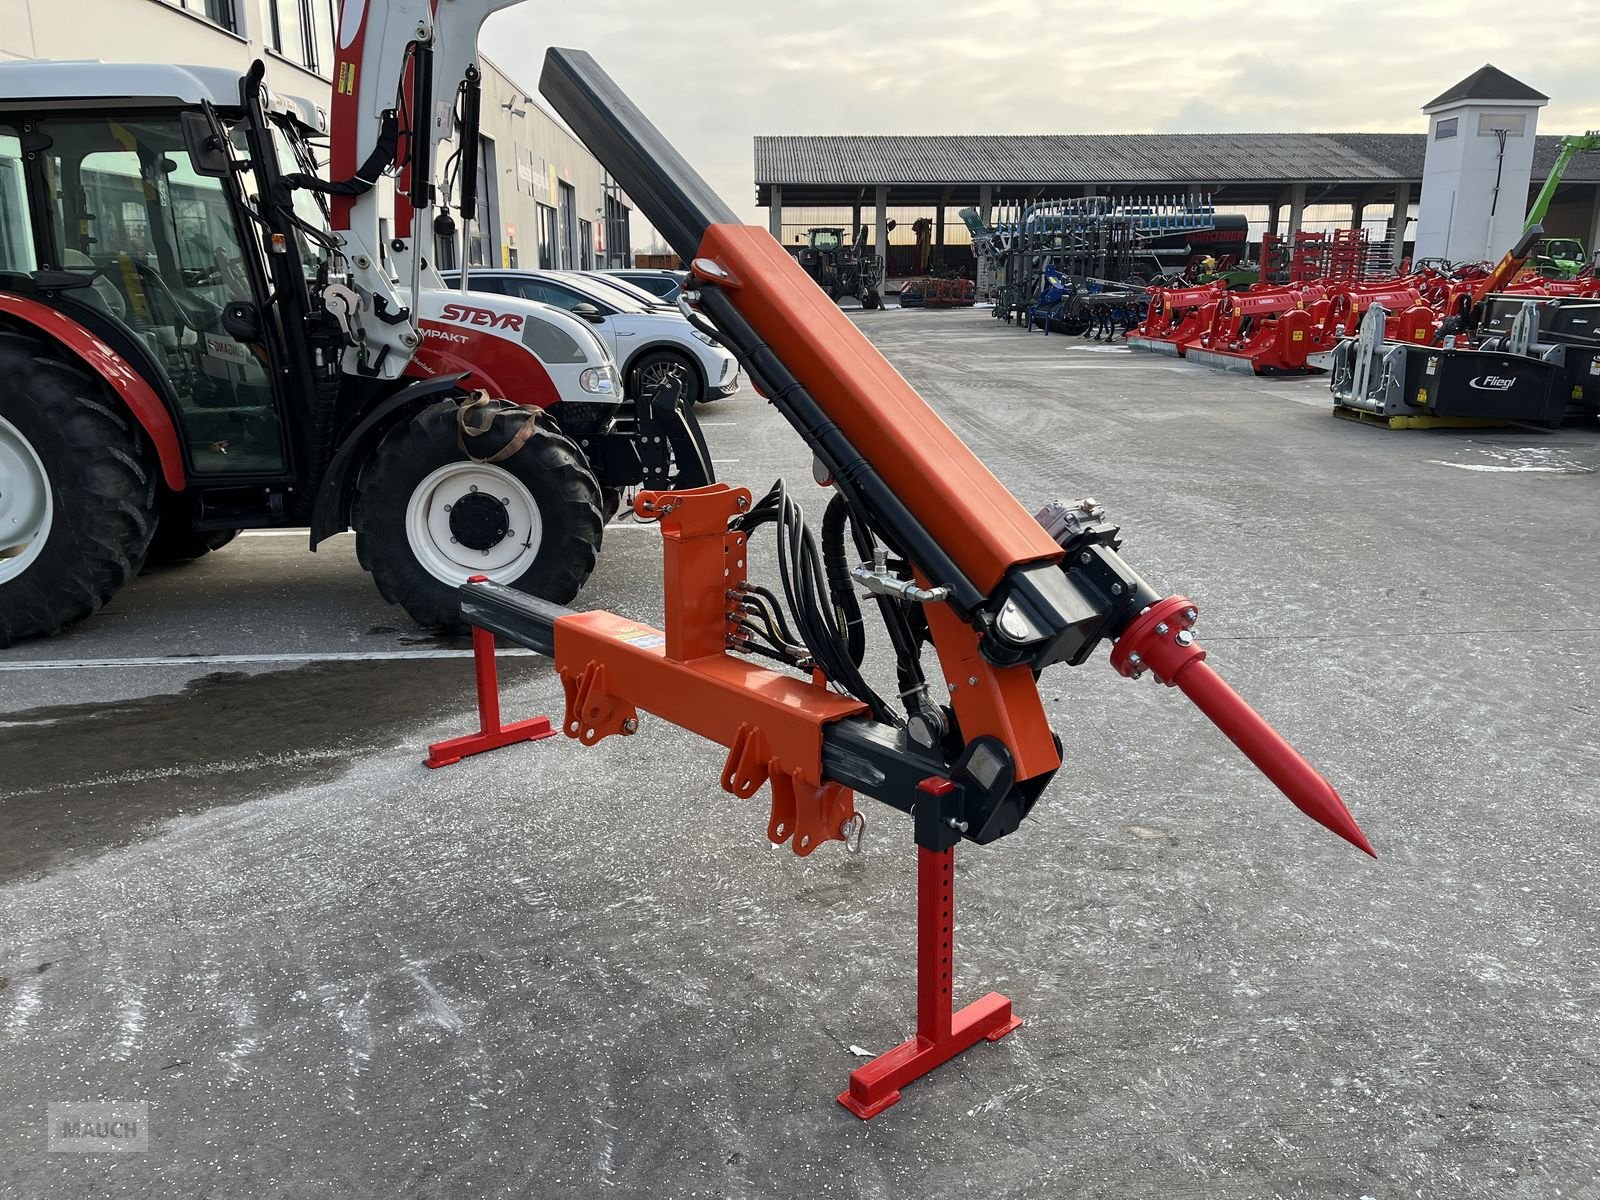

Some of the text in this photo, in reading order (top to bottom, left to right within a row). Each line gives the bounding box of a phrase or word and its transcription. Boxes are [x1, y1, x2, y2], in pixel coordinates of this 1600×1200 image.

[439, 303, 524, 332] STEYR
[419, 327, 469, 344] MPAKT
[1482, 375, 1517, 389] Fliegl
